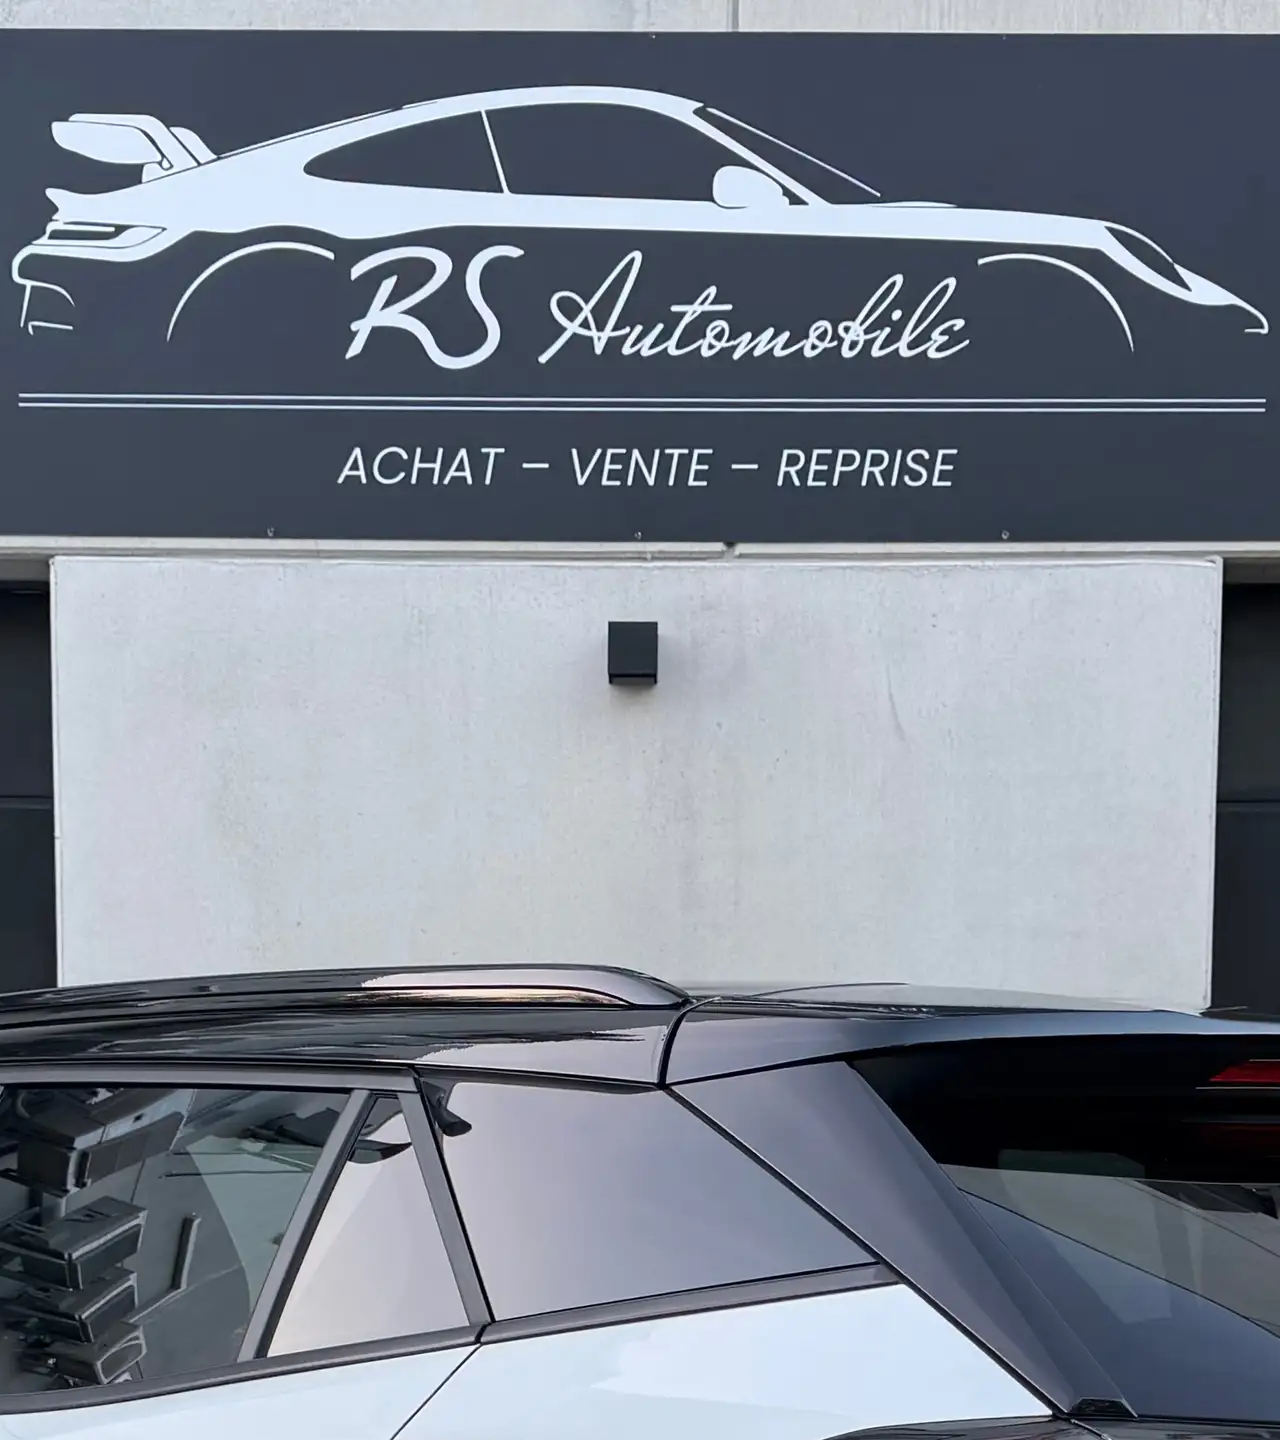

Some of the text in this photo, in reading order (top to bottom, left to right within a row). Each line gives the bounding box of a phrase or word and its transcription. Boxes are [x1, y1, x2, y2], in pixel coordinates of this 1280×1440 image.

[345, 245, 970, 370] RS Automobile
[336, 446, 506, 486] ACHAT
[571, 448, 714, 487] VENTE
[777, 448, 958, 487] REPRISE
